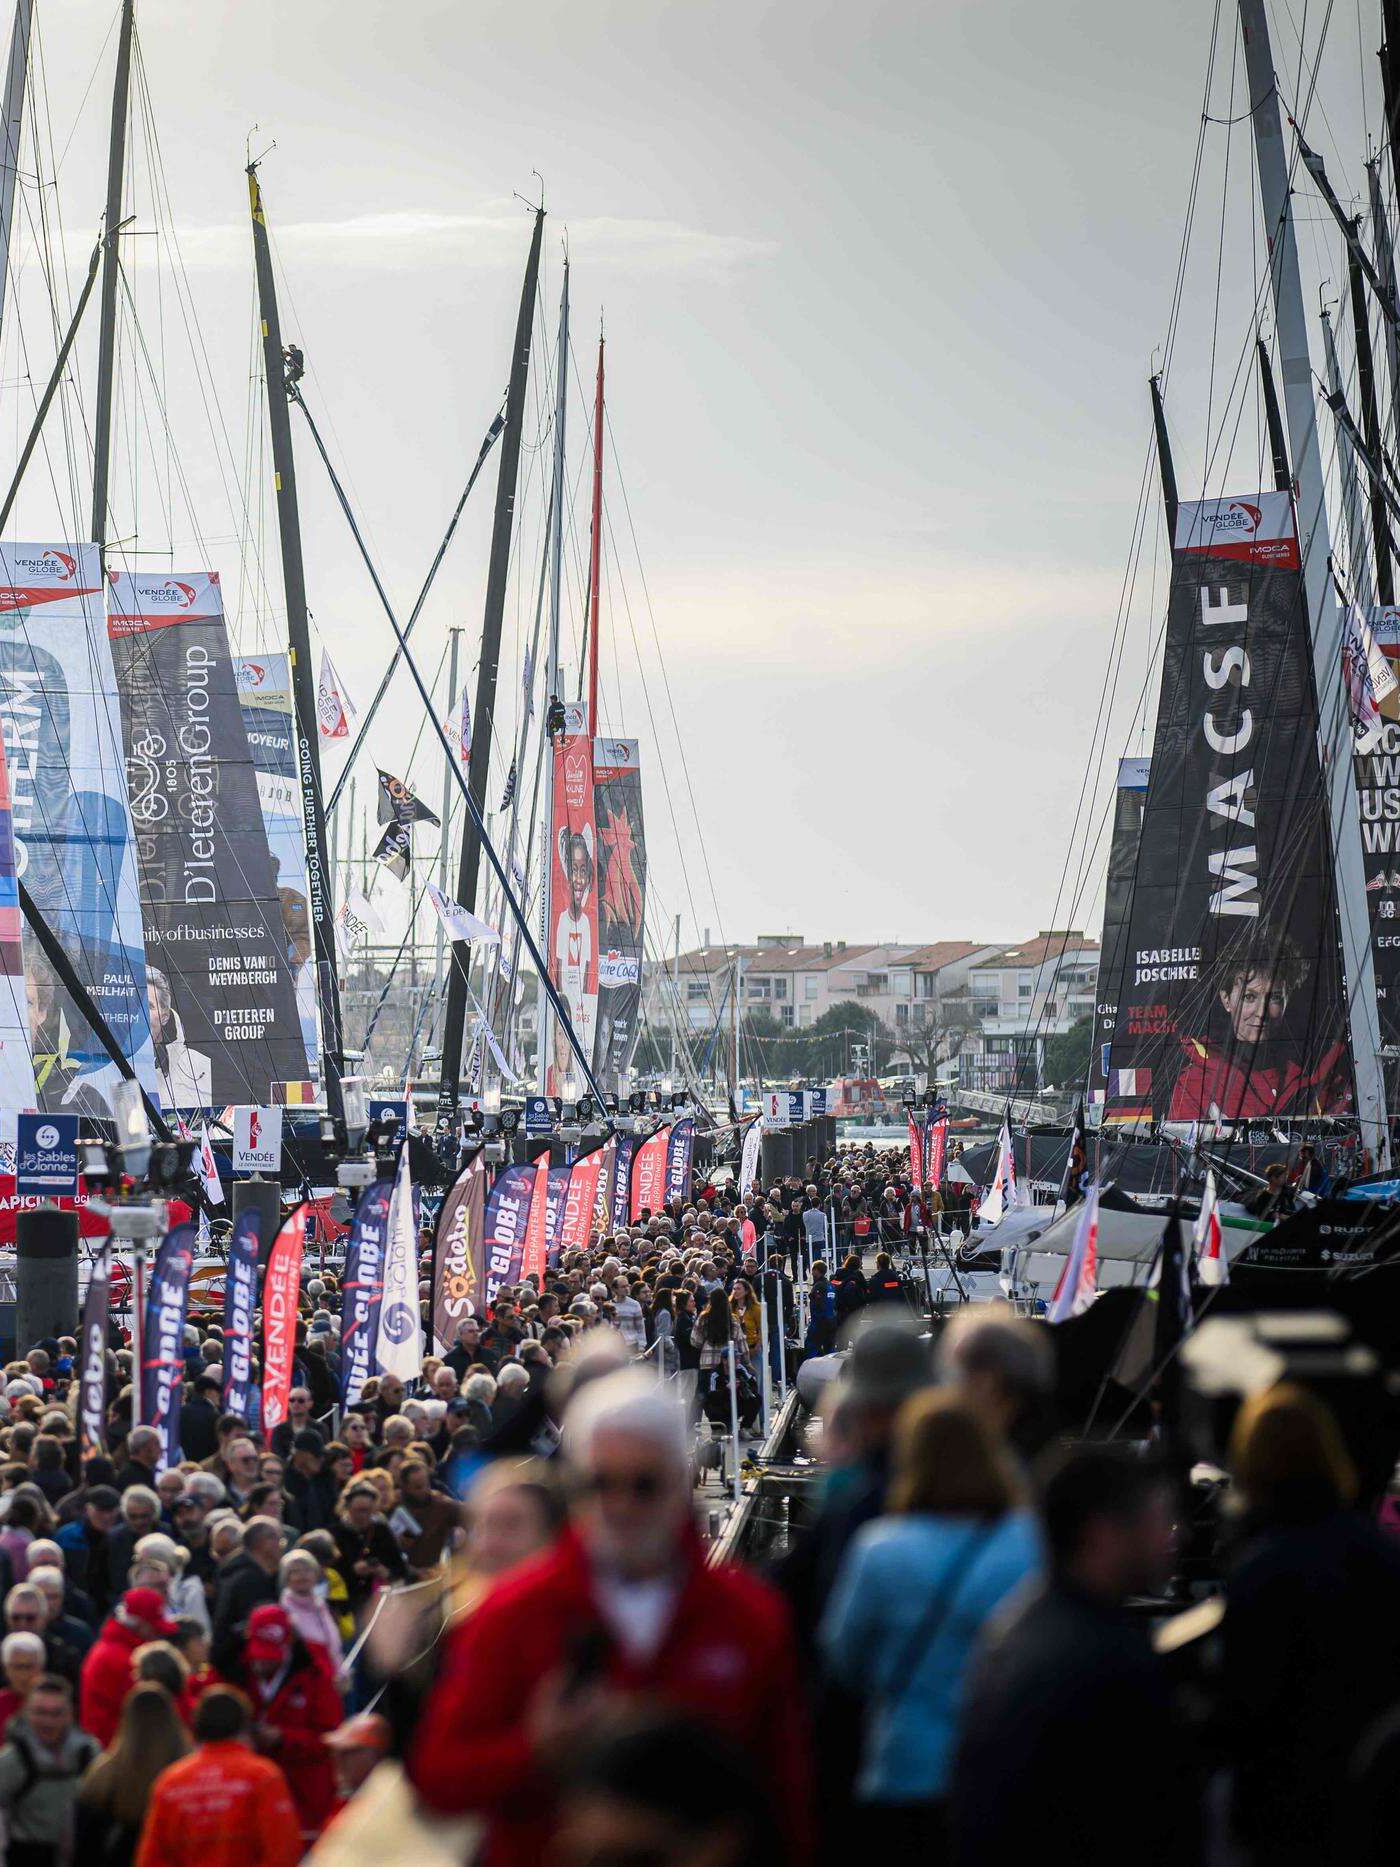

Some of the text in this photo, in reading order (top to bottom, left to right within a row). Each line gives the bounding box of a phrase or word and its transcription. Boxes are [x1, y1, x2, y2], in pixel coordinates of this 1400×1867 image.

[1202, 511, 1244, 523] VENDÉE
[1215, 517, 1249, 529] GLOBE
[14, 558, 59, 567] VENDÉE
[28, 566, 63, 574] GLOBE
[138, 587, 178, 596] VENDÉE
[1199, 584, 1261, 918] MACSF
[300, 737, 324, 923] GOING FURTHER TOGETHER
[166, 923, 186, 942] of
[186, 923, 265, 942] businesses
[208, 955, 266, 972] DENIS VAN
[1136, 946, 1200, 966] ISABELLE
[103, 973, 135, 984] PAUL
[208, 971, 278, 987] WEYNBERGH
[1134, 964, 1198, 988] JOSCHKE
[86, 985, 137, 998] MEILHAT
[1127, 1004, 1169, 1019] TEAM
[224, 1025, 266, 1041] GROUP
[23, 1150, 76, 1163] les Sables
[238, 1150, 275, 1162] VENDÉE
[674, 1138, 686, 1186] GLOBE
[490, 1194, 521, 1274] GLOBE
[444, 1204, 476, 1318] Sodebo
[229, 1259, 252, 1383] GLOBE
[263, 1253, 290, 1391] VENDÉE
